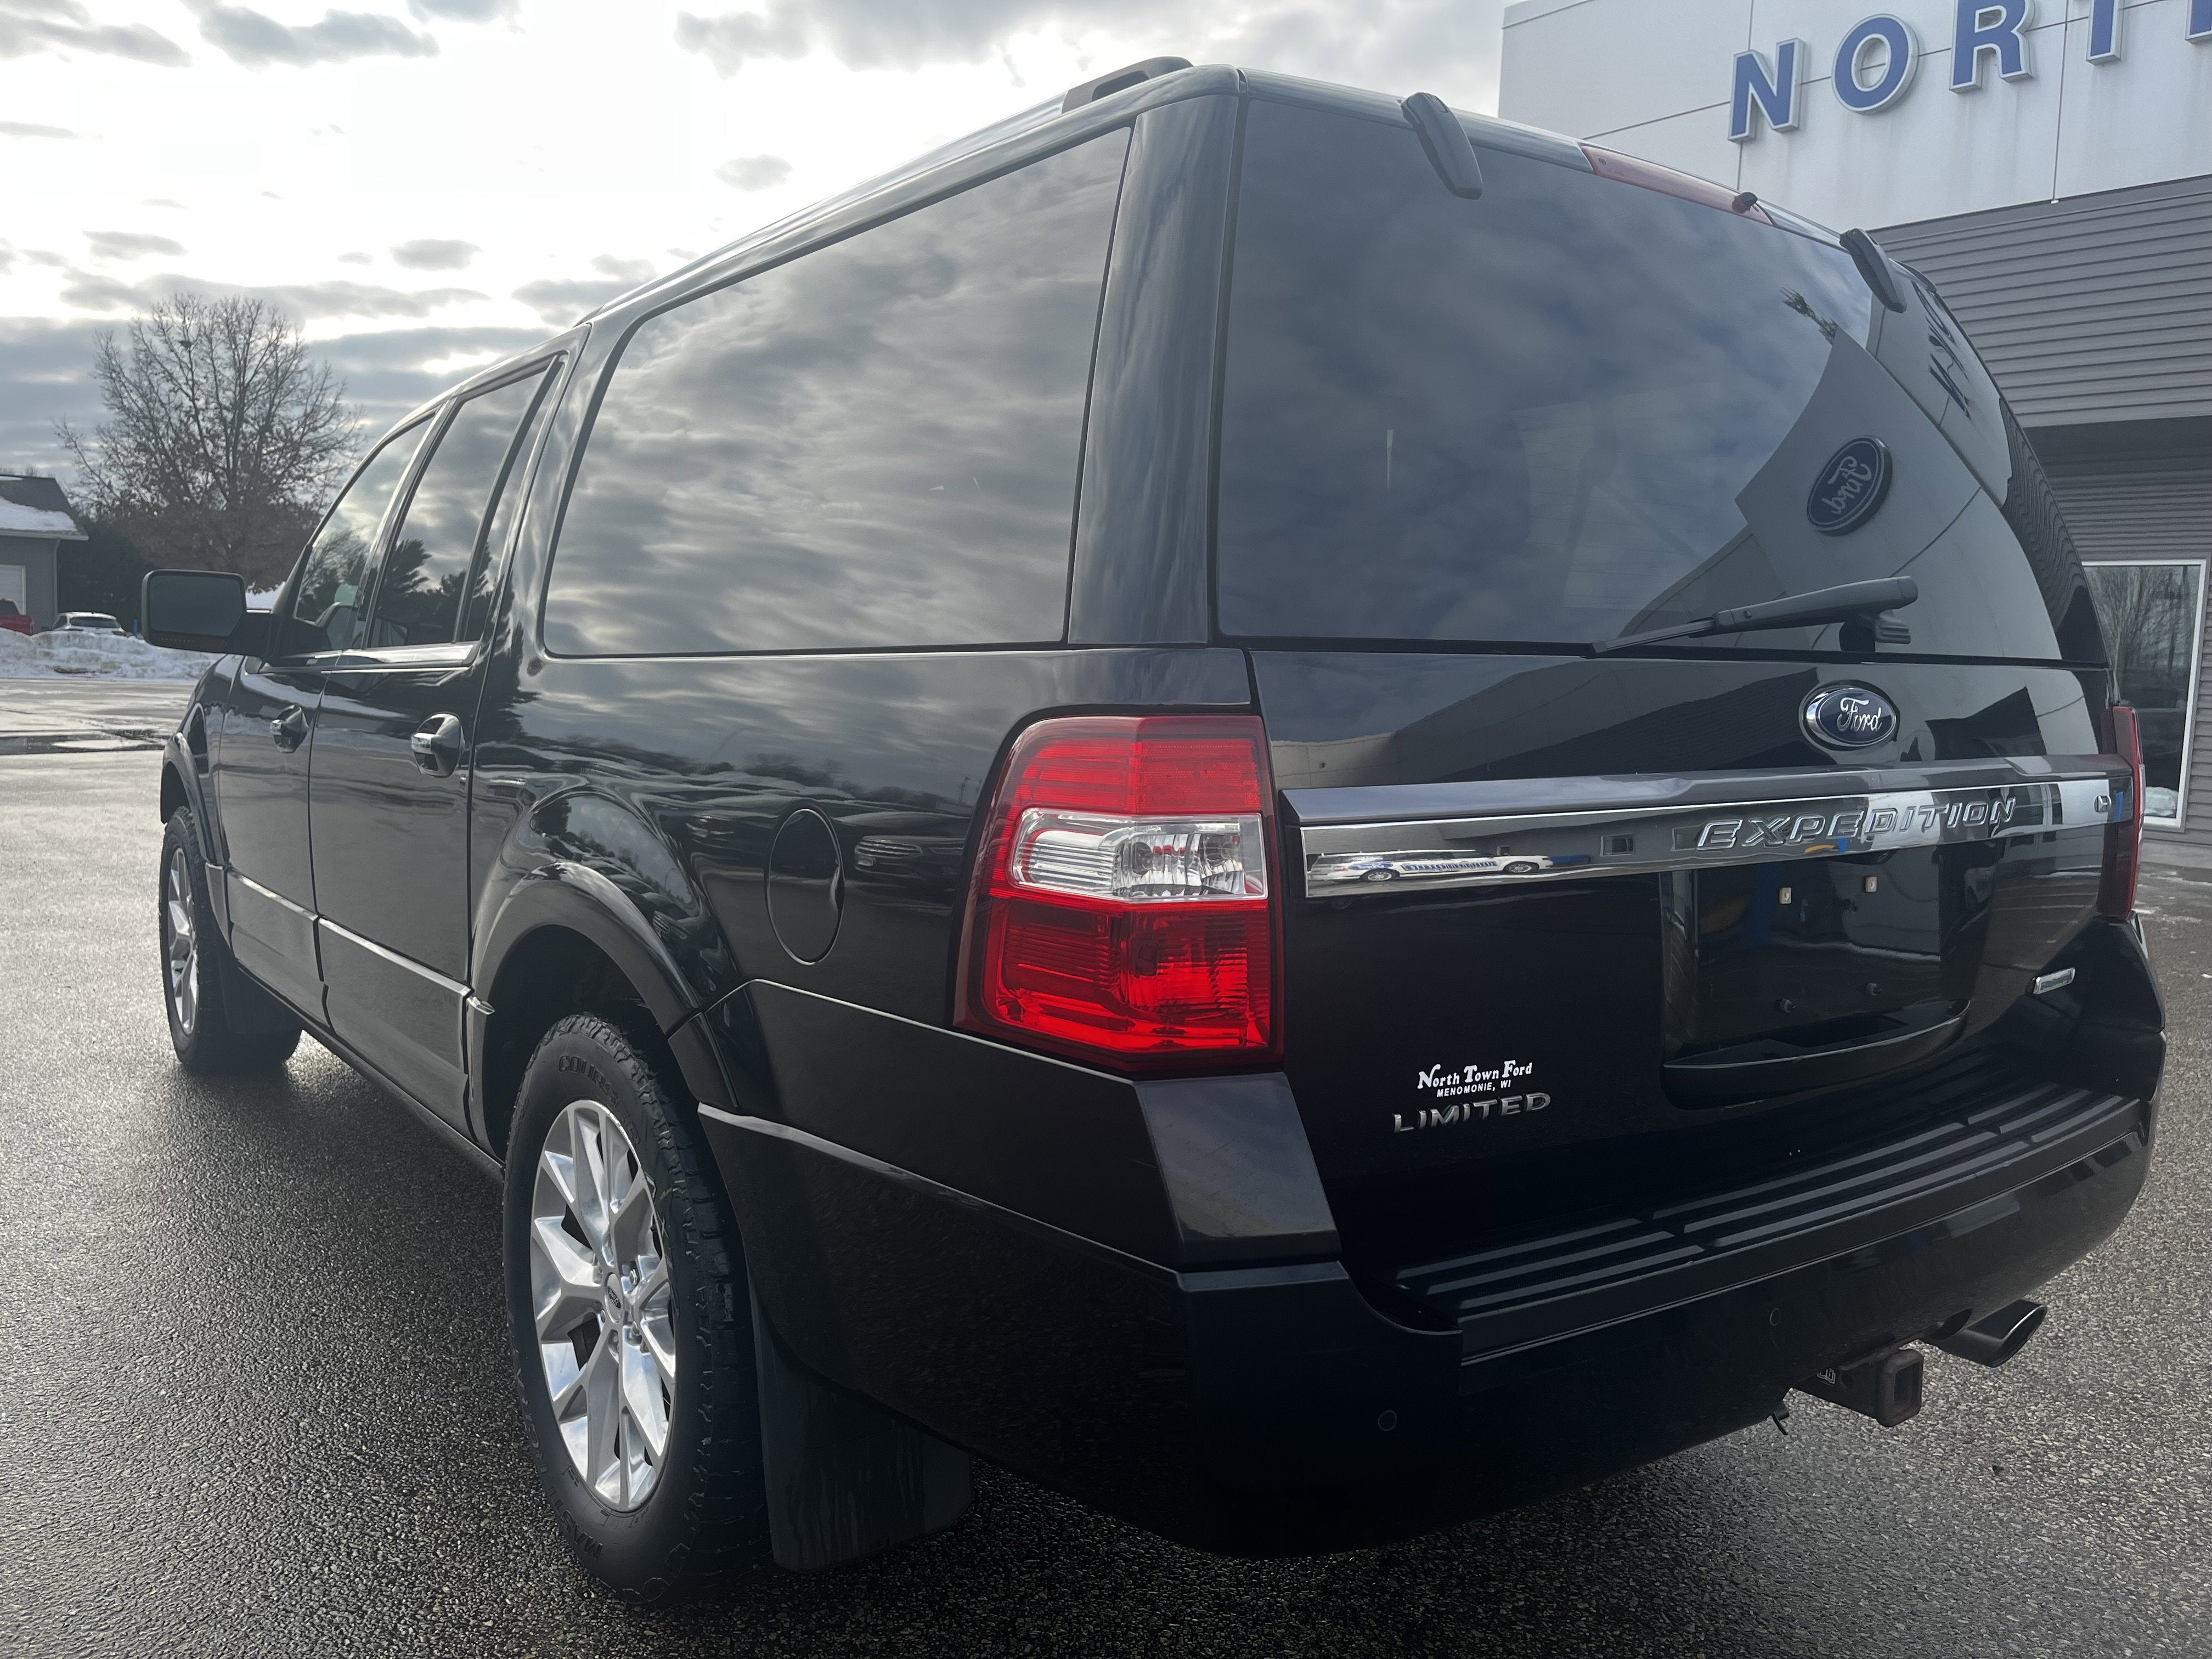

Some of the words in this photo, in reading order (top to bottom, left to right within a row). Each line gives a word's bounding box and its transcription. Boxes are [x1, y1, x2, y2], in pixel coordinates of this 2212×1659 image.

[1837, 697, 1882, 732] Ford
[1697, 797, 2017, 851] EXPEDITION
[1417, 1063, 1460, 1089] North
[1464, 1064, 1499, 1084] Town
[1502, 1060, 1533, 1078] Ford
[1436, 1082, 1496, 1098] MENOMONIE,
[1500, 1080, 1511, 1088] WI
[1393, 1092, 1551, 1133] LIMITED
